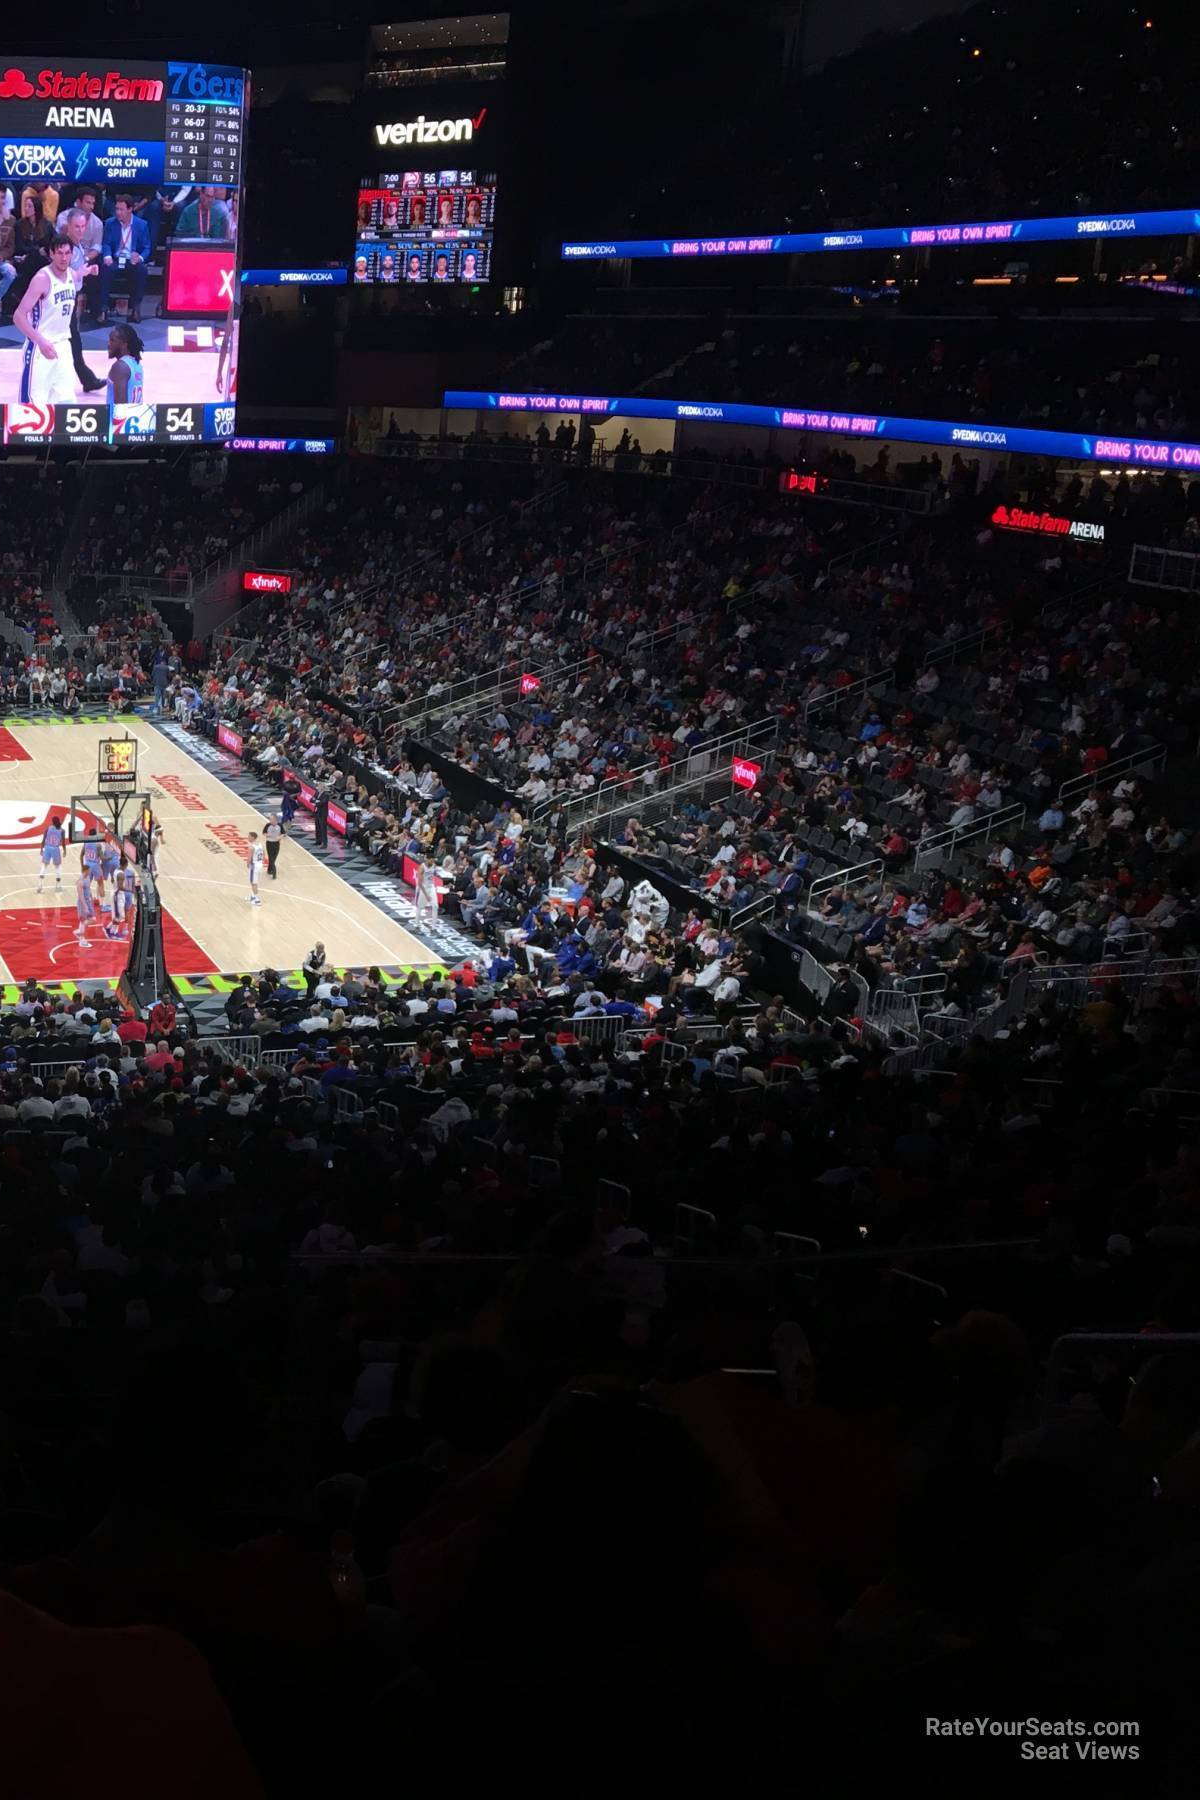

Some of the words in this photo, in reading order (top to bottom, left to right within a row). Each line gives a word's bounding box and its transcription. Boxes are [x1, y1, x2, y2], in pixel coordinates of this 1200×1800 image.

[168, 65, 243, 97] 76ers
[46, 107, 114, 128] ARENA
[185, 119, 205, 127] 06-07
[184, 132, 204, 140] 08-13
[376, 116, 472, 144] verizon
[4, 145, 65, 161] SVEDKA
[108, 147, 137, 156] BRING
[189, 146, 198, 154] 21
[4, 161, 66, 176] VODKA
[96, 158, 122, 166] YOUR
[125, 158, 148, 167] OWN
[107, 169, 137, 177] SPIRIT
[424, 174, 435, 183] 56
[461, 172, 472, 181] 54
[911, 230, 935, 243] BRING
[937, 229, 960, 241] YOUR
[963, 228, 982, 240] OWN
[985, 226, 1012, 239] SPIRIT
[673, 242, 698, 253] BRING
[701, 242, 725, 253] YOUR
[728, 240, 746, 251] OWN
[749, 239, 773, 250] SPIRIT
[499, 396, 527, 407] BRING
[531, 397, 556, 408] YOUR
[560, 398, 579, 409] OWN
[583, 399, 609, 411] SPIRIT
[66, 408, 97, 433] 56
[166, 408, 193, 431] 54
[782, 412, 805, 425] BRING
[807, 414, 828, 427] YOUR
[830, 416, 849, 429] OWN
[851, 417, 877, 432] SPIRIT
[233, 440, 254, 448] OWN
[258, 441, 286, 450] SPIRIT
[1096, 441, 1130, 457] BRING
[1135, 444, 1168, 461] YOUR
[1173, 448, 1200, 464] OWN
[1070, 521, 1104, 540] ARENA
